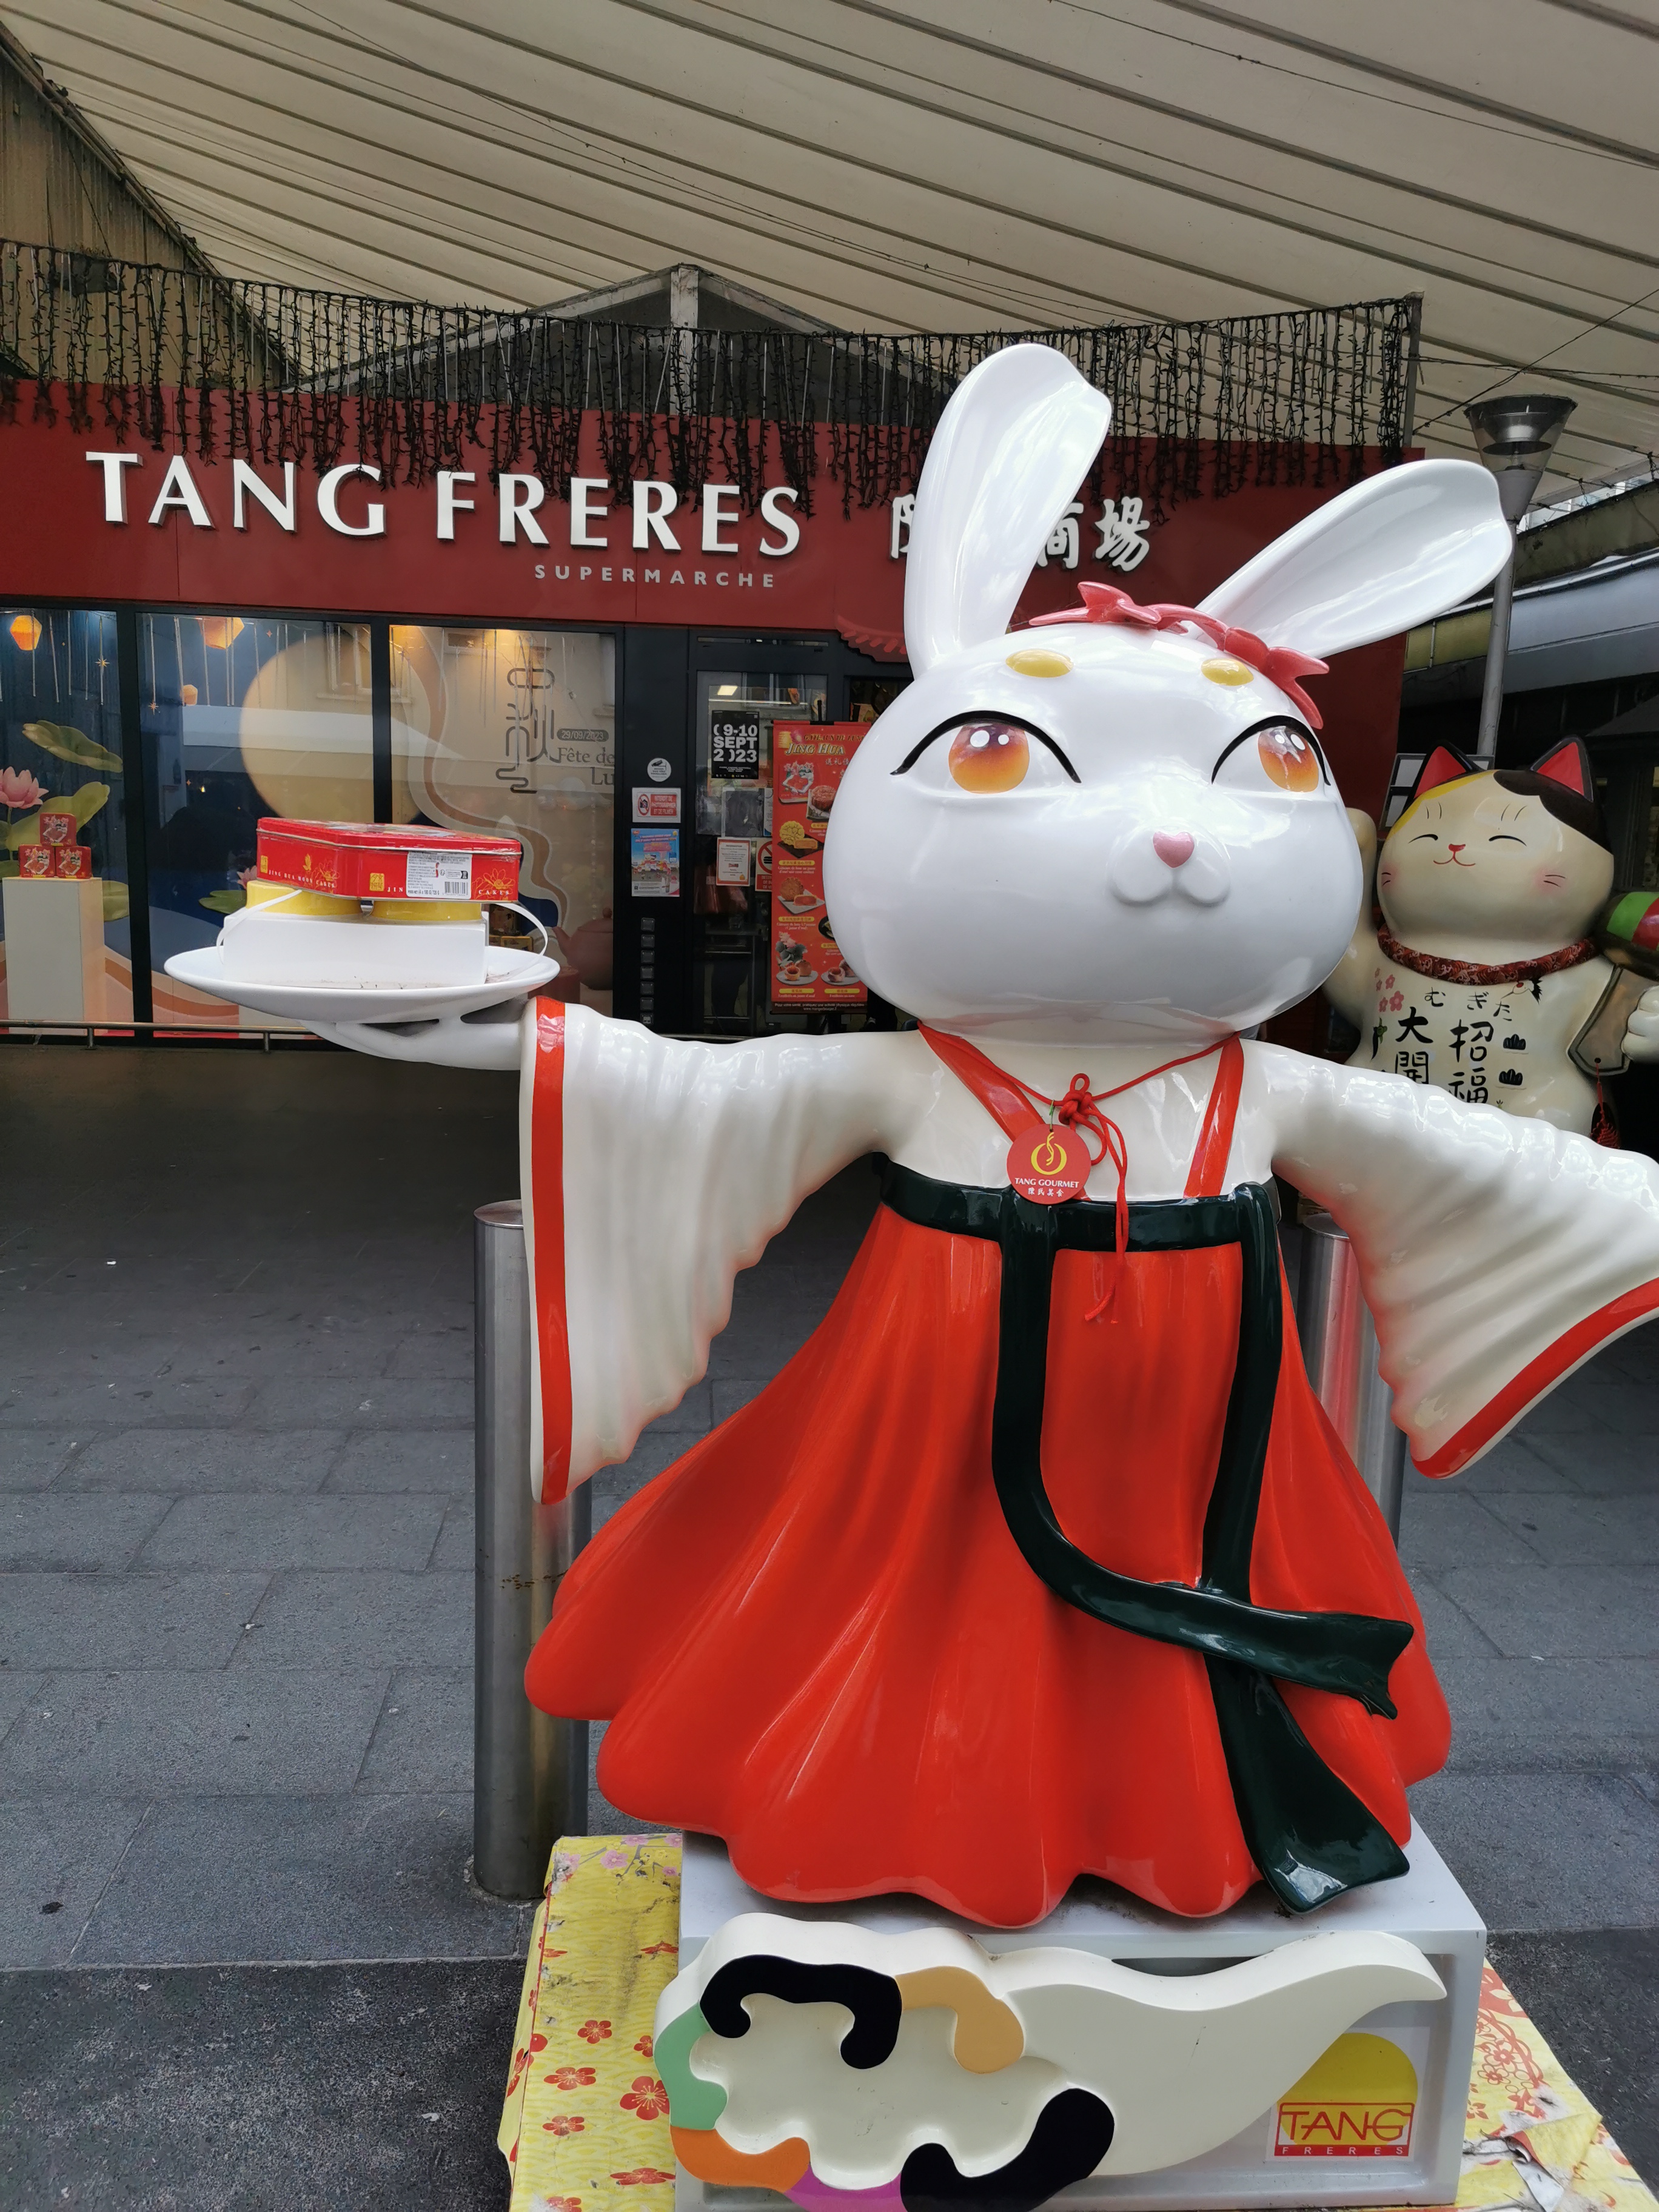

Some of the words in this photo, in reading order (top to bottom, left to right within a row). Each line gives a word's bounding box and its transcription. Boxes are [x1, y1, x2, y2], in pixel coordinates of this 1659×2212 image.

[85, 451, 386, 537] TANG
[436, 469, 800, 557] FRERES
[534, 564, 776, 588] SUPERMARCHE
[561, 730, 605, 740] 29/09/2023
[713, 736, 757, 749] SEPT
[786, 743, 815, 754] JING
[817, 743, 845, 754] HUA
[558, 746, 591, 763] Fête
[595, 746, 615, 763] de
[589, 766, 615, 785] Lu
[316, 880, 335, 888] CAKES
[1038, 1179, 1079, 1188] GOURMET
[1028, 1187, 1064, 1197] 陳氏美食
[1281, 2108, 1413, 2141] TANG
[1282, 2147, 1404, 2155] FRERES
